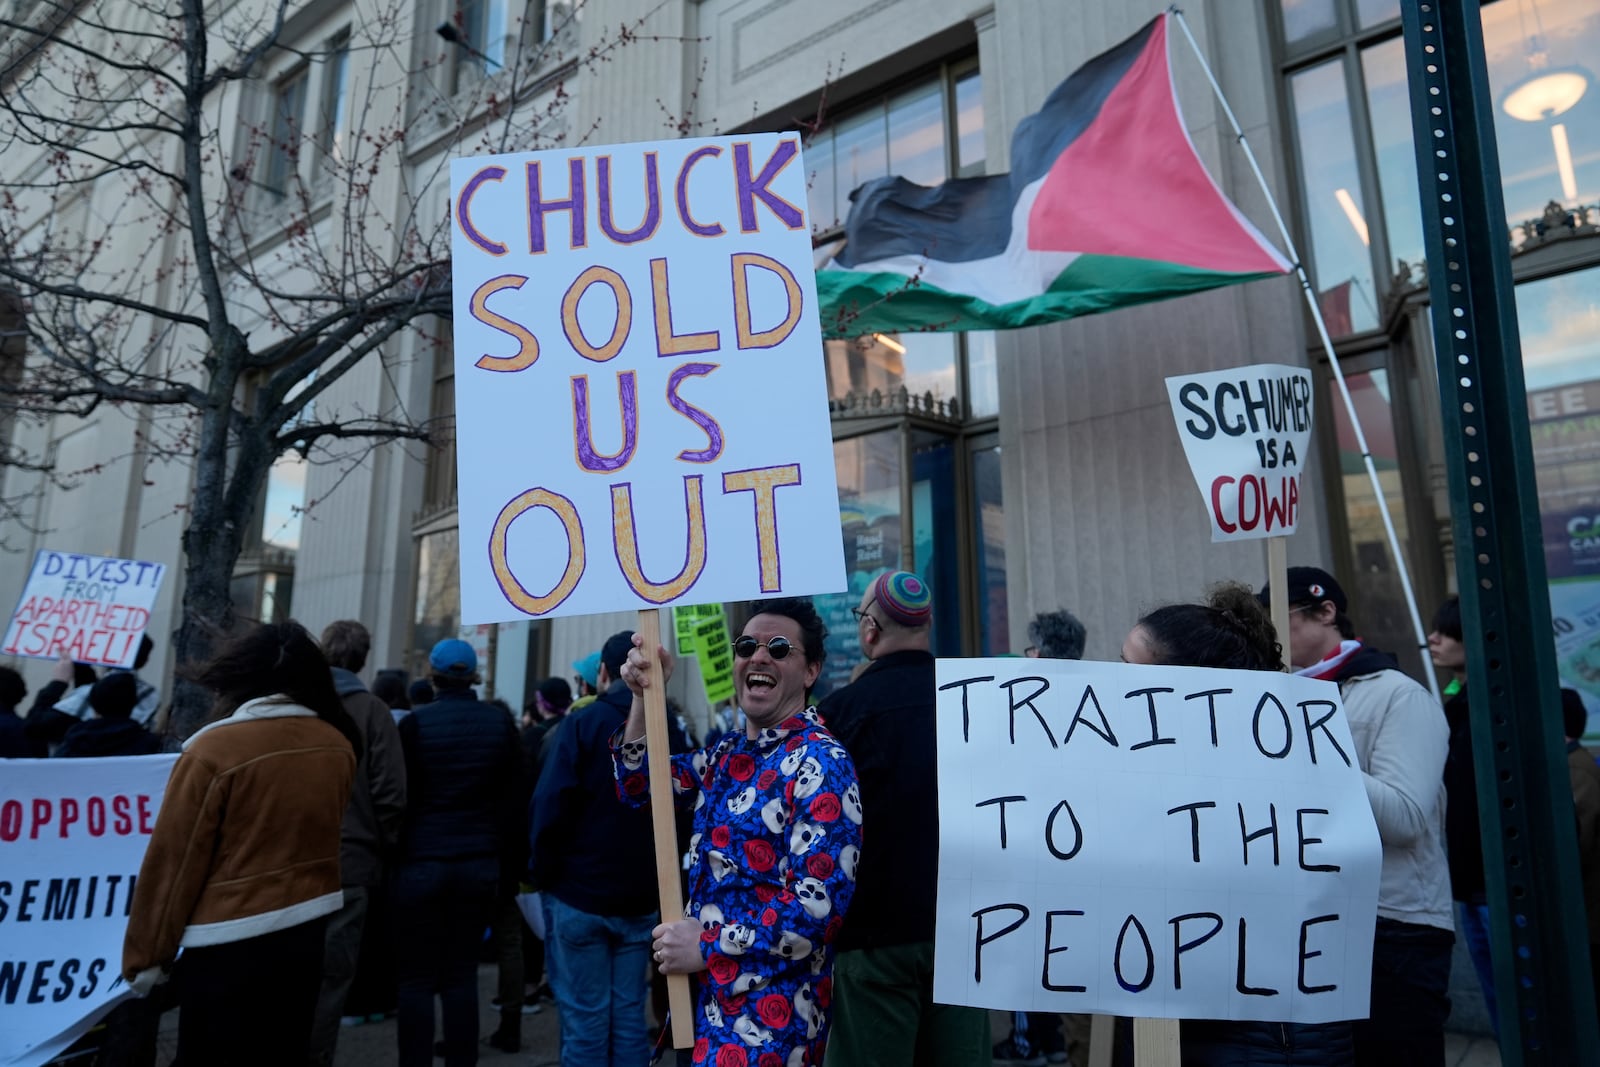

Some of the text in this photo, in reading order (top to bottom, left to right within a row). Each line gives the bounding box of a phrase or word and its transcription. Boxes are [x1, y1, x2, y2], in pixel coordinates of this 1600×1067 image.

[456, 138, 805, 256] CHUCK
[470, 252, 803, 372] SOLD
[570, 362, 725, 474] US
[1179, 375, 1311, 440] SCHUMER
[1256, 438, 1297, 468] IS A
[1211, 472, 1301, 533] COWA
[43, 553, 162, 588] DIVEST!
[488, 463, 801, 616] OUT
[14, 595, 151, 632] APARTHEID
[61, 579, 118, 601] FROM
[5, 620, 134, 664] ISRAEL!
[938, 676, 1352, 767] TRAITOR
[0, 795, 152, 842] OPPOSE
[975, 795, 1341, 872] TO THE
[972, 903, 1340, 996] PEOPLE
